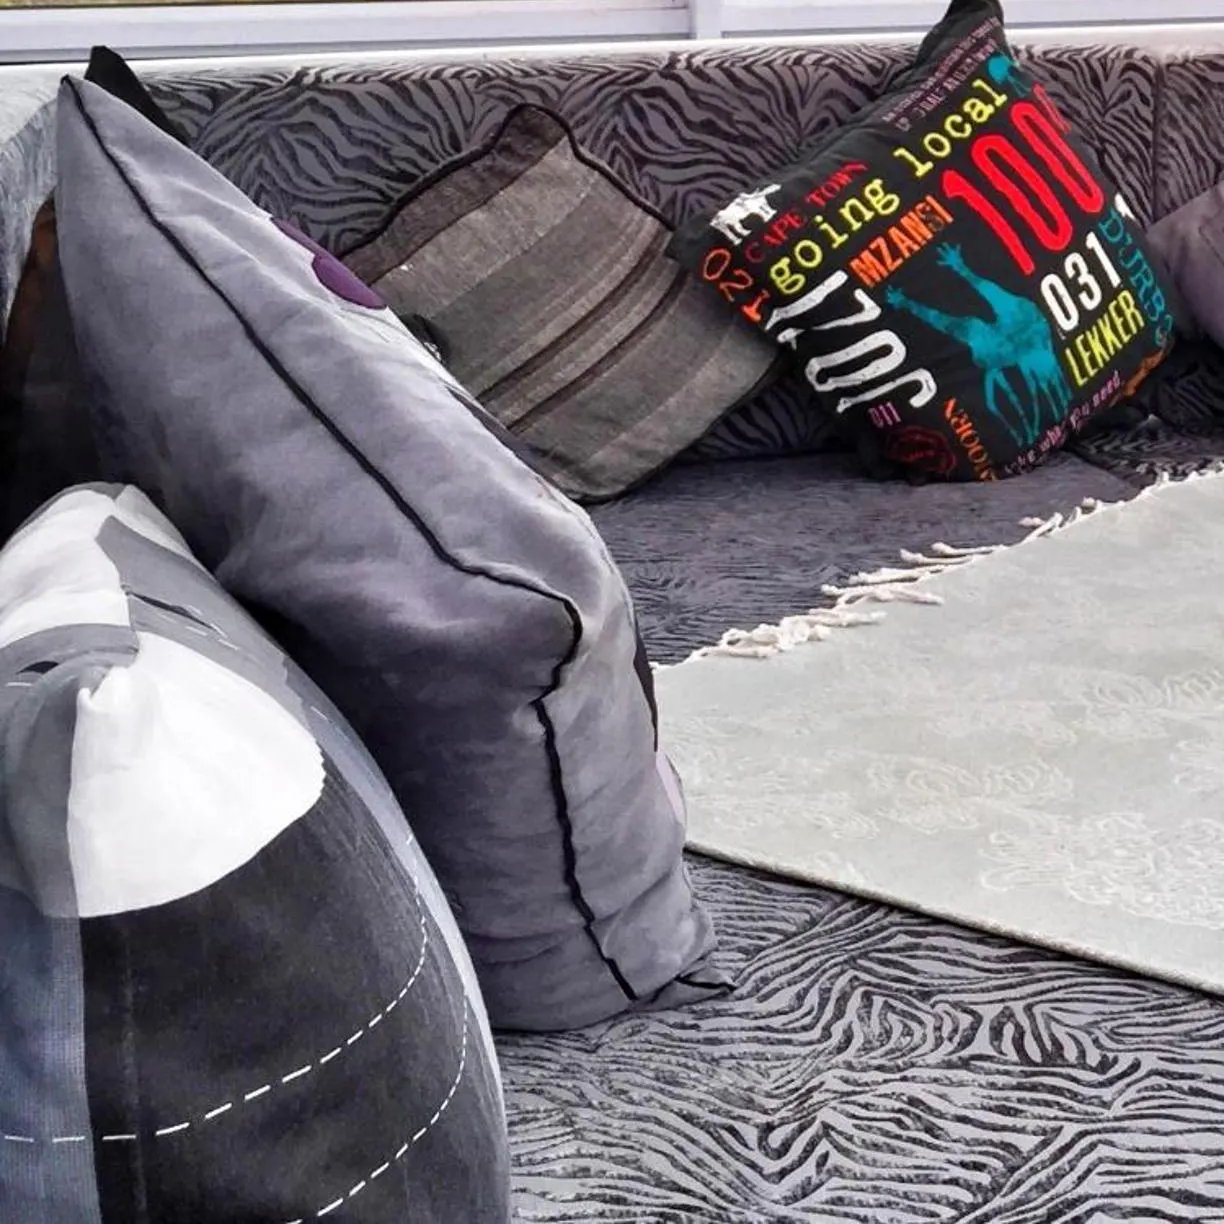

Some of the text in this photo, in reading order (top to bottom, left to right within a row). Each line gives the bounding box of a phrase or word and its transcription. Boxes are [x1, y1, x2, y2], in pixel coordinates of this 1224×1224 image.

[769, 178, 900, 295] going
[893, 78, 1009, 177] local
[744, 208, 803, 264] CAPE
[850, 193, 954, 288] MZANSI
[1040, 231, 1122, 332] 031
[702, 247, 770, 323] 021
[1064, 289, 1146, 388] LEKKER
